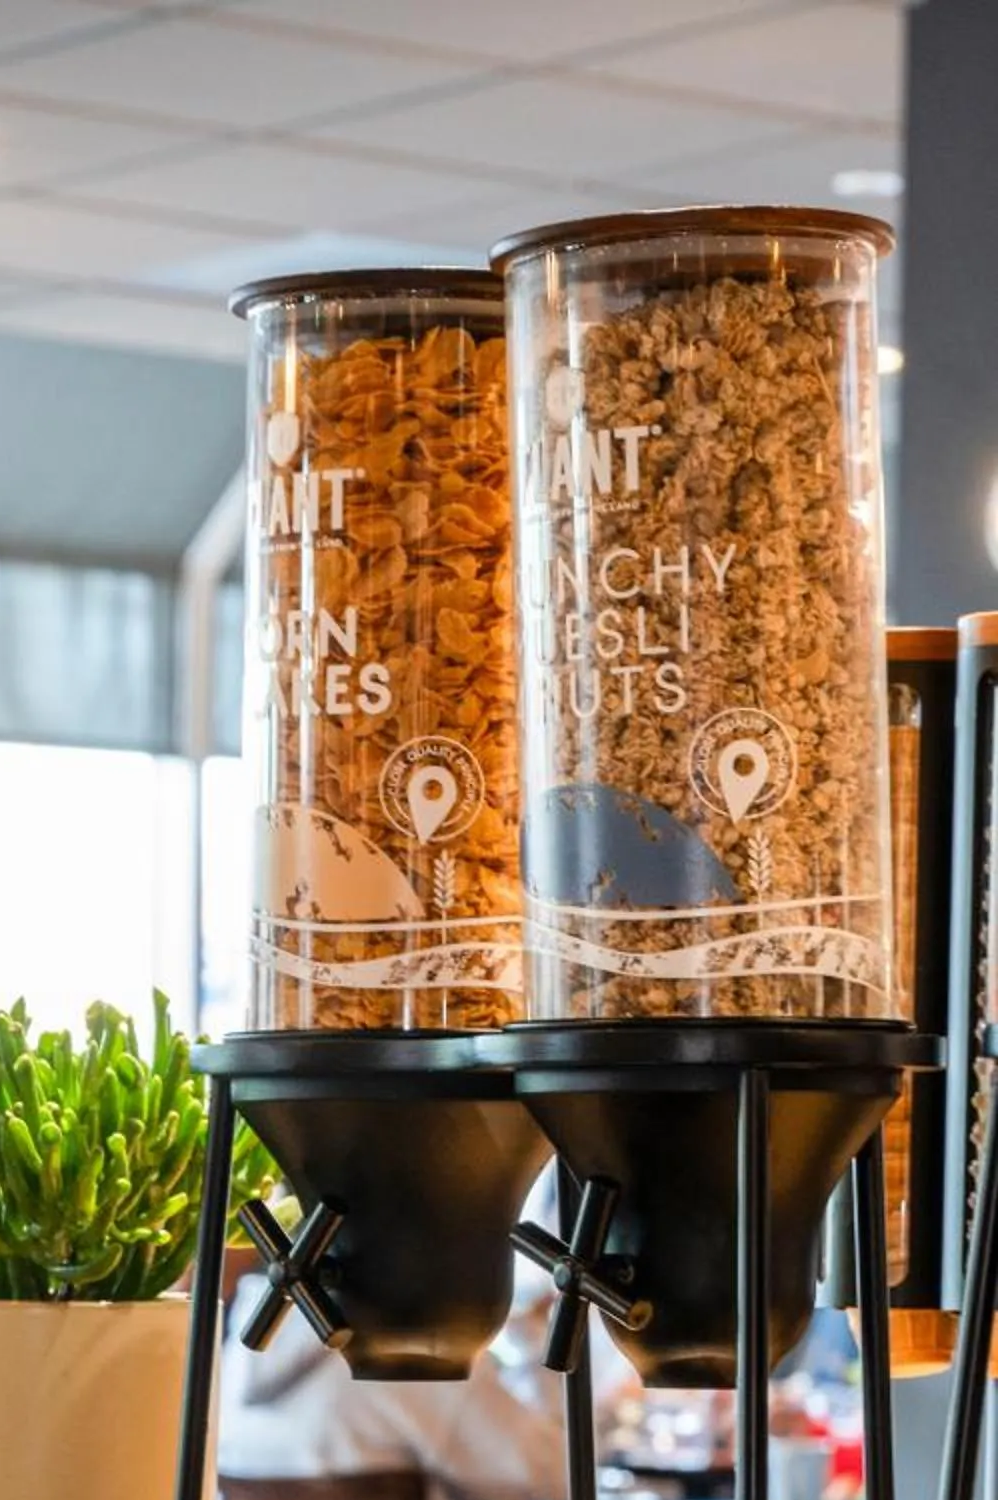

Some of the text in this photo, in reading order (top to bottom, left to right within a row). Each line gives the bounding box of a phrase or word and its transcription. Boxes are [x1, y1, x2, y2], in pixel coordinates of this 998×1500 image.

[551, 426, 652, 500] ANT
[268, 469, 352, 536] ANT
[259, 606, 358, 662] ORN
